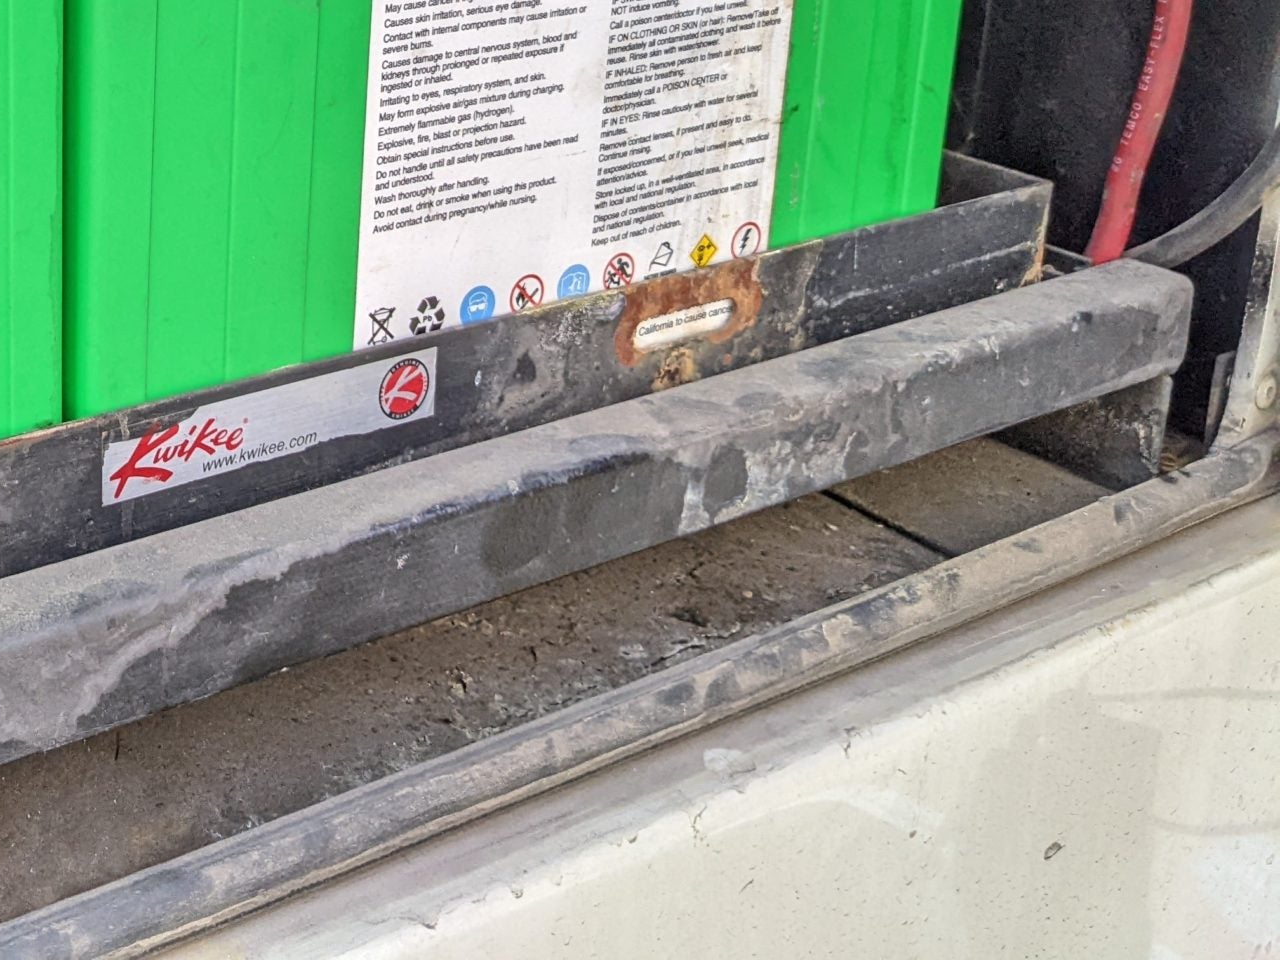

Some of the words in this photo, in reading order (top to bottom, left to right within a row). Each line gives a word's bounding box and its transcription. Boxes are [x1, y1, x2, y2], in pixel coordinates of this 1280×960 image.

[384, 17, 414, 29] Causes
[415, 13, 431, 24] skin
[466, 5, 494, 16] serious
[495, 3, 510, 13] eye
[385, 3, 402, 14] May
[403, 0, 427, 11] cause
[379, 95, 411, 107] Irritating
[412, 93, 420, 102] to
[442, 83, 483, 96] respiratory
[514, 74, 529, 85] and
[1119, 102, 1143, 146] TEMCO
[1138, 15, 1166, 91] EASY-FLEX
[379, 112, 396, 122] May
[397, 109, 414, 119] form
[415, 102, 451, 116] explosive
[452, 98, 478, 109] air/gas
[479, 93, 507, 104] mixture
[508, 89, 531, 100] during
[378, 122, 416, 137] Extremely
[417, 115, 456, 129] flammable
[457, 113, 472, 124] gas
[432, 129, 451, 141] blast
[452, 129, 461, 137] or
[462, 122, 498, 137] projection
[376, 153, 402, 166] Obtain
[403, 147, 430, 162] special
[430, 141, 473, 155] instructions
[474, 136, 499, 147] before
[376, 170, 388, 180] Do
[388, 167, 401, 177] not
[402, 162, 428, 174] handle
[429, 158, 445, 170] until
[446, 156, 455, 166] all
[456, 153, 480, 164] safety
[480, 146, 523, 162] precautions
[524, 142, 542, 152] have
[543, 138, 561, 148] been
[562, 133, 579, 145] read
[374, 193, 396, 205] Wash
[398, 185, 437, 201] thoroughly
[438, 182, 456, 193] after
[375, 180, 390, 191] and
[372, 221, 395, 234] Avoid
[395, 216, 423, 229] contact
[423, 212, 448, 223] during
[448, 199, 508, 220] pregnancy/while
[638, 319, 674, 337] California
[675, 316, 683, 326] to
[684, 312, 706, 324] cause
[109, 417, 245, 499] Kwikee
[202, 429, 318, 473] www.kwikee.com
